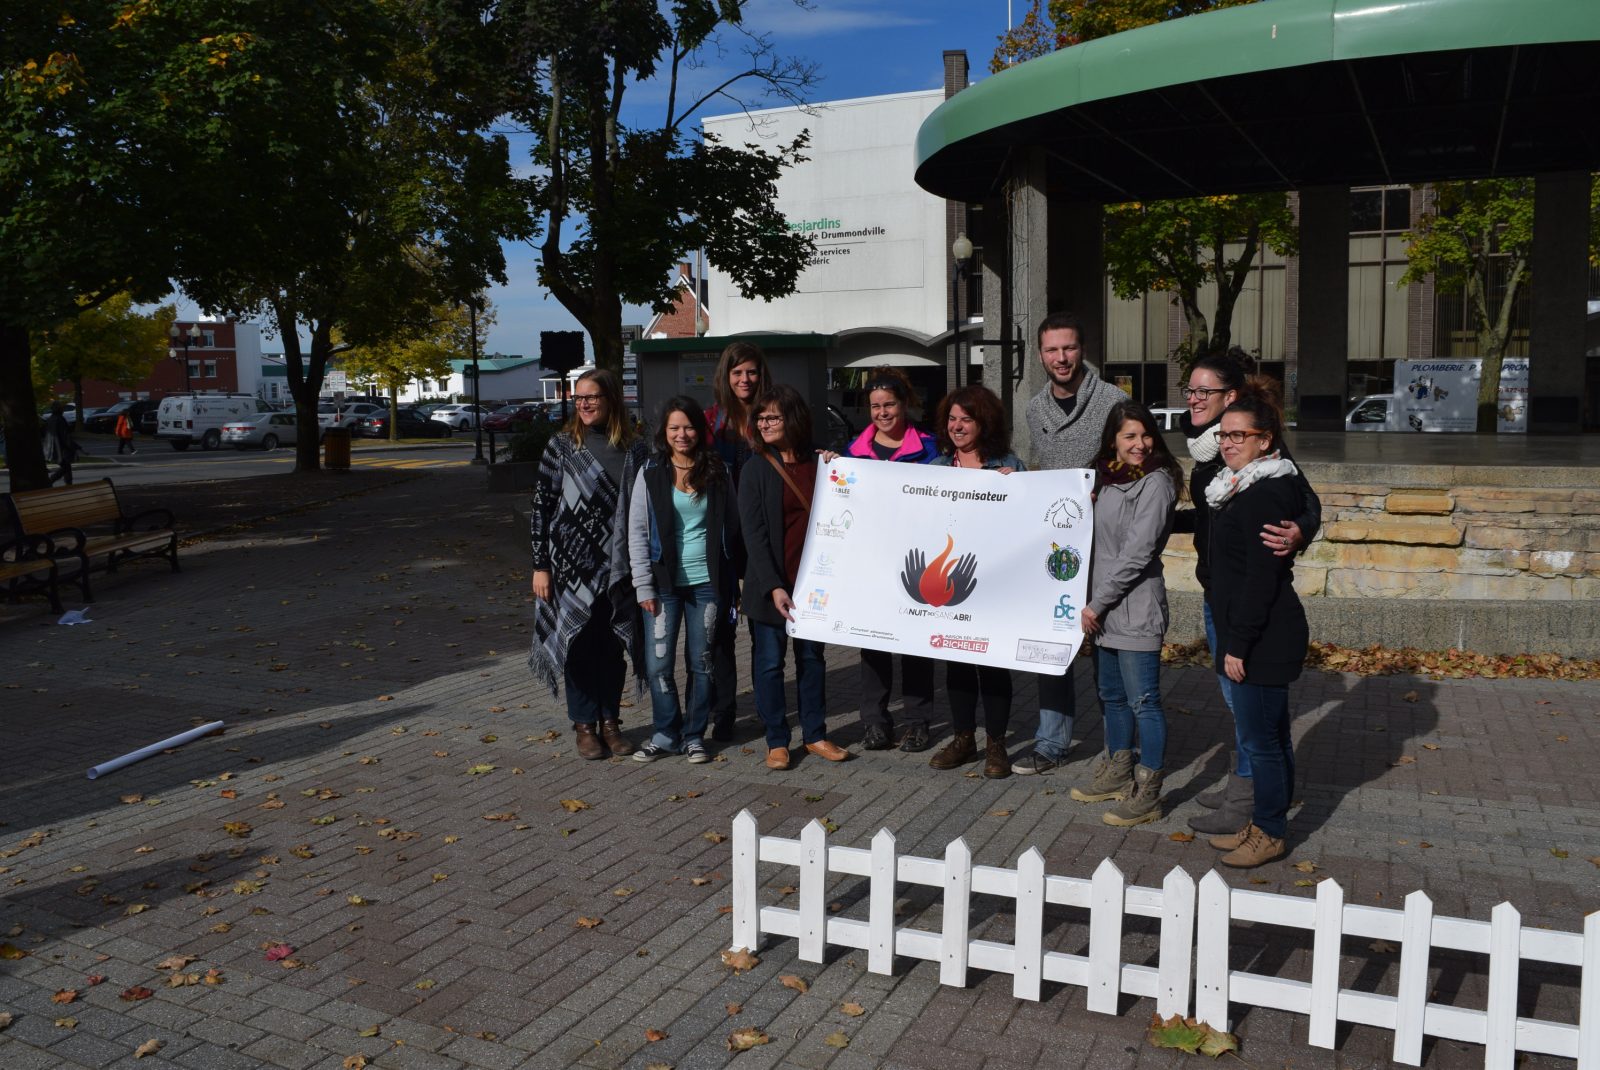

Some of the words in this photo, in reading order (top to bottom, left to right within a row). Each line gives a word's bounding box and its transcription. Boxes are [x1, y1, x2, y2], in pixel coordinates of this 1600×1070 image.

[821, 227, 885, 239] Drummondville
[820, 248, 850, 256] services
[1411, 364, 1465, 372] PLOMBERIE
[902, 484, 939, 497] Comité
[941, 489, 1008, 502] organisateur
[943, 640, 987, 652] RICHELIEU
